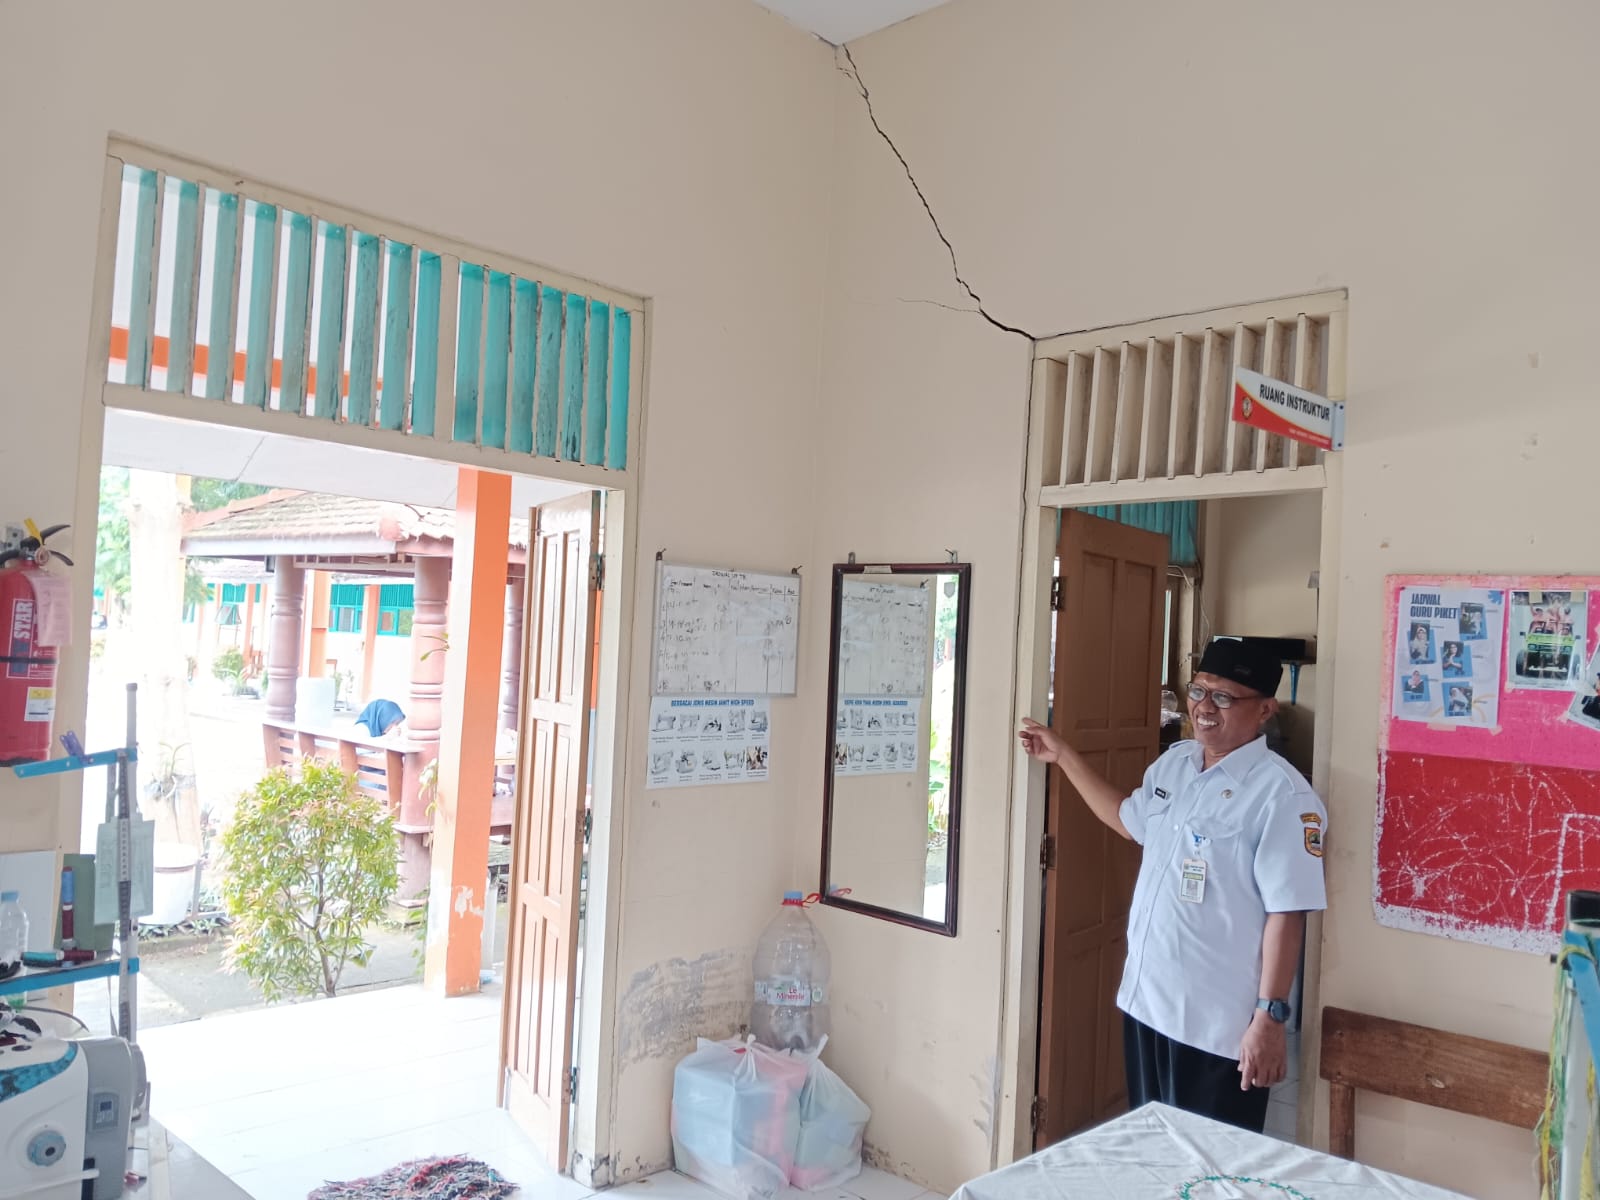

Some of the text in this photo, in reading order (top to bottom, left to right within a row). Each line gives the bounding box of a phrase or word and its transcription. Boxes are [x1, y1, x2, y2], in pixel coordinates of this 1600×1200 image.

[1259, 383, 1330, 421] RUANG INSTRUKTUR
[1410, 593, 1441, 606] JADWAL
[1410, 605, 1458, 619] GURU PIKET
[13, 600, 33, 640] STAR
[789, 985, 798, 994] Le
